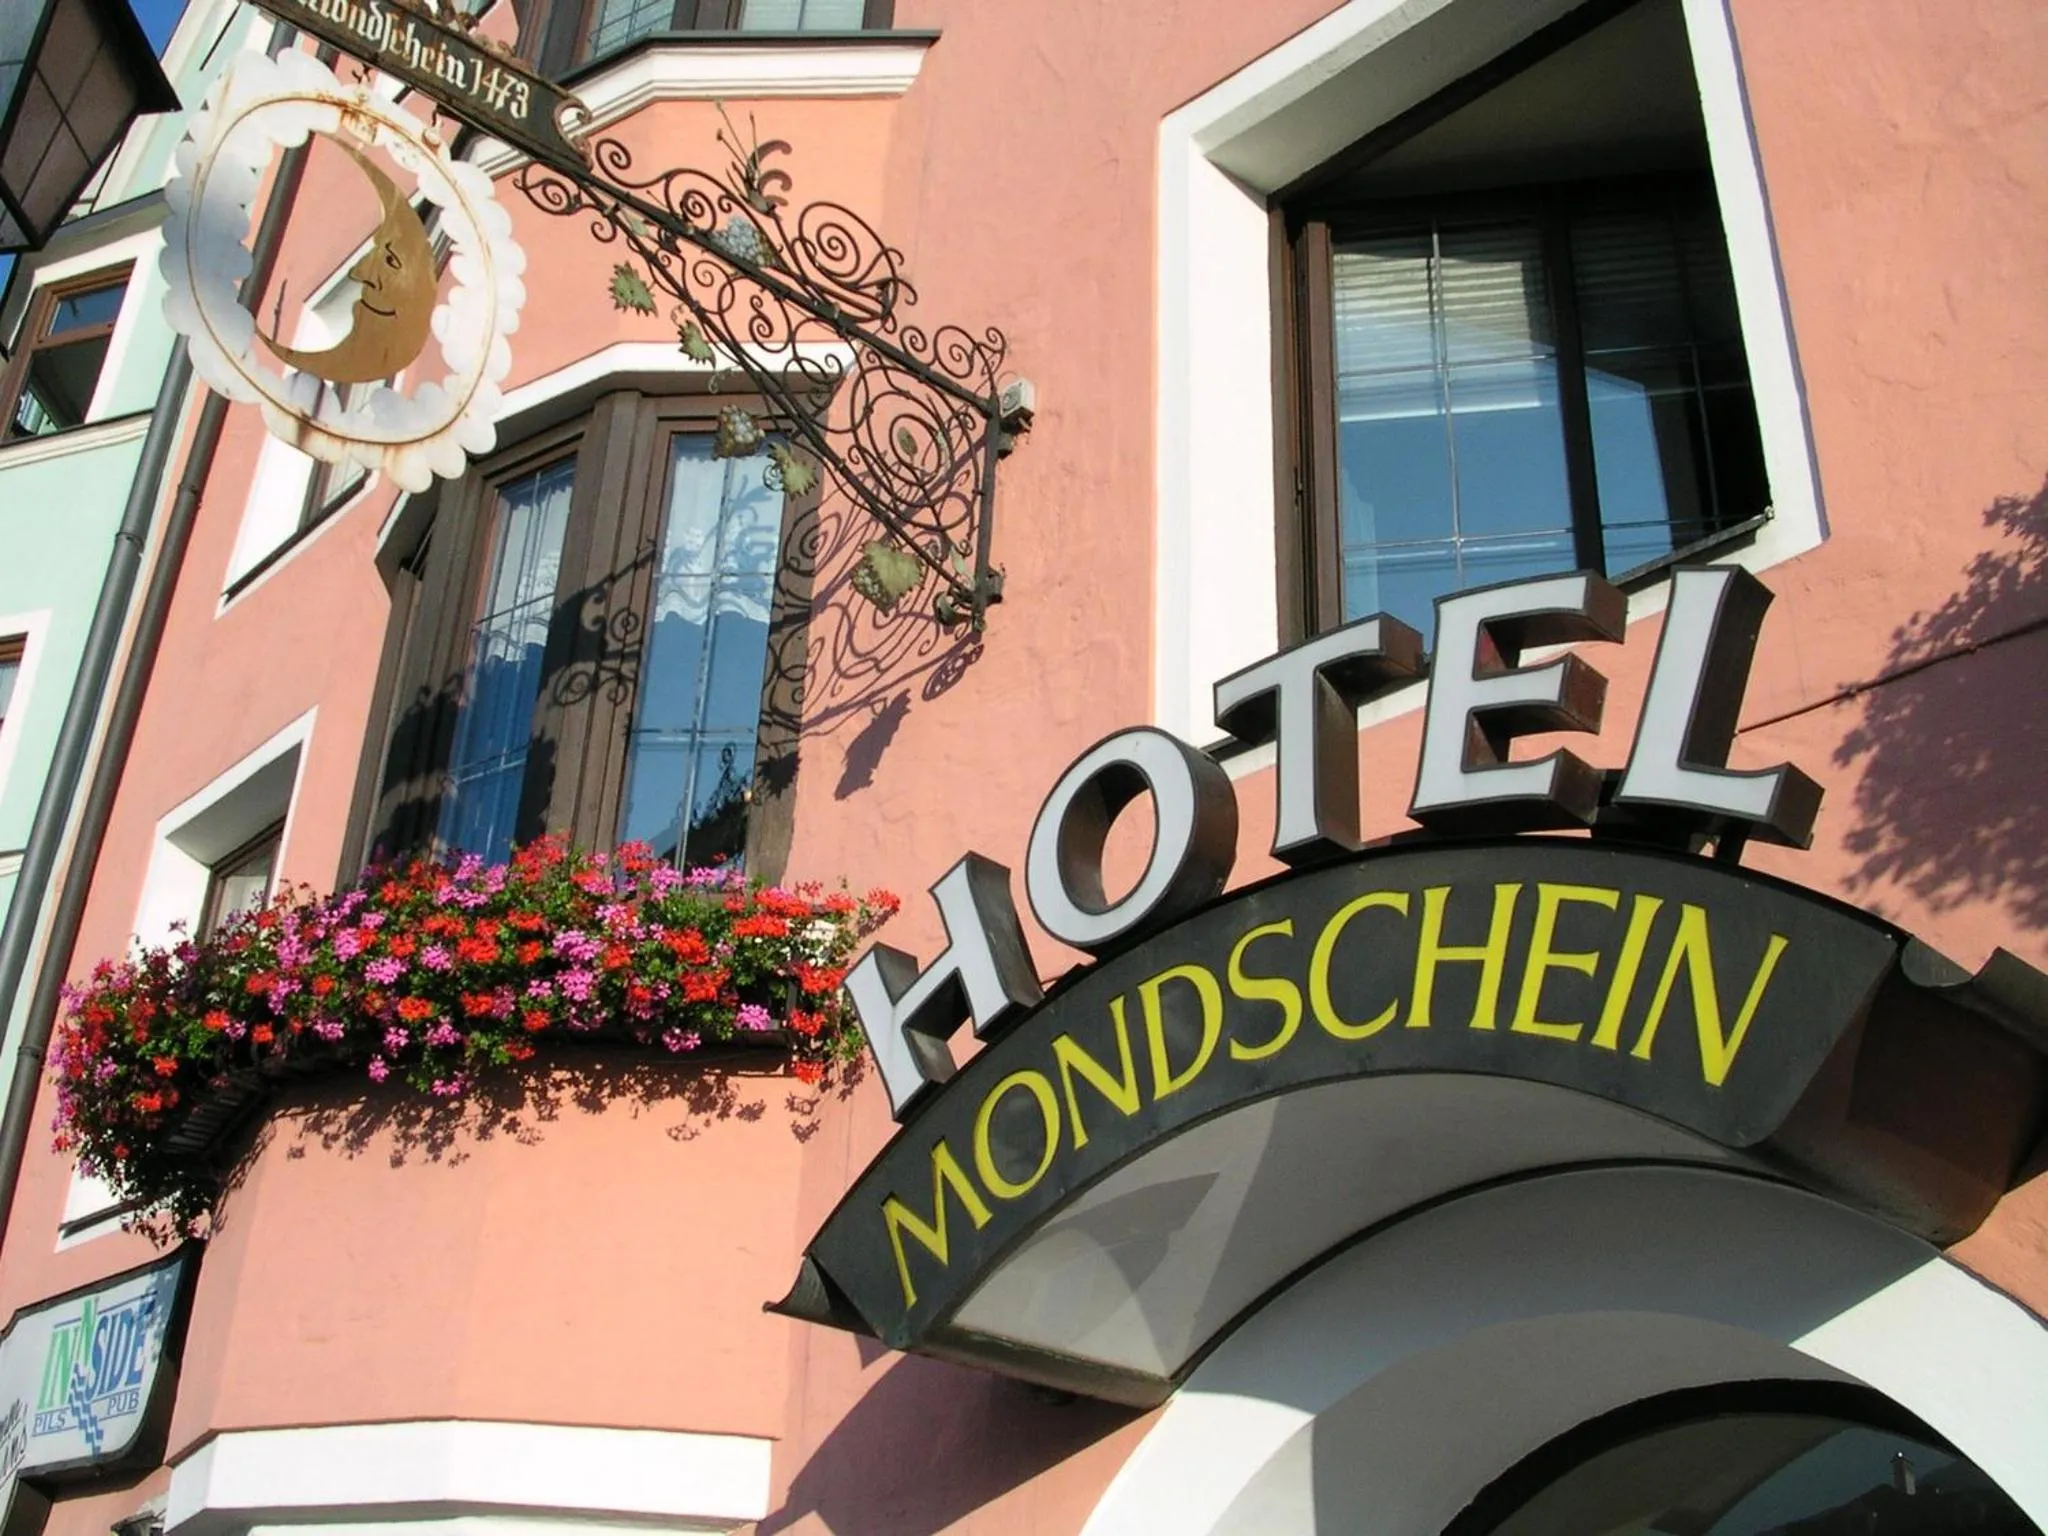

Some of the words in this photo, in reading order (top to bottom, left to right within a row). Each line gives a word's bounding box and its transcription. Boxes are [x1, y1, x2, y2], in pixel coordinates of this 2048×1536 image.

[468, 58, 530, 119] 1473
[845, 565, 1798, 1121] HOTEL
[880, 882, 1789, 1309] MONDSCHEIN
[33, 1410, 68, 1434] PILS
[106, 1390, 140, 1416] PUB
